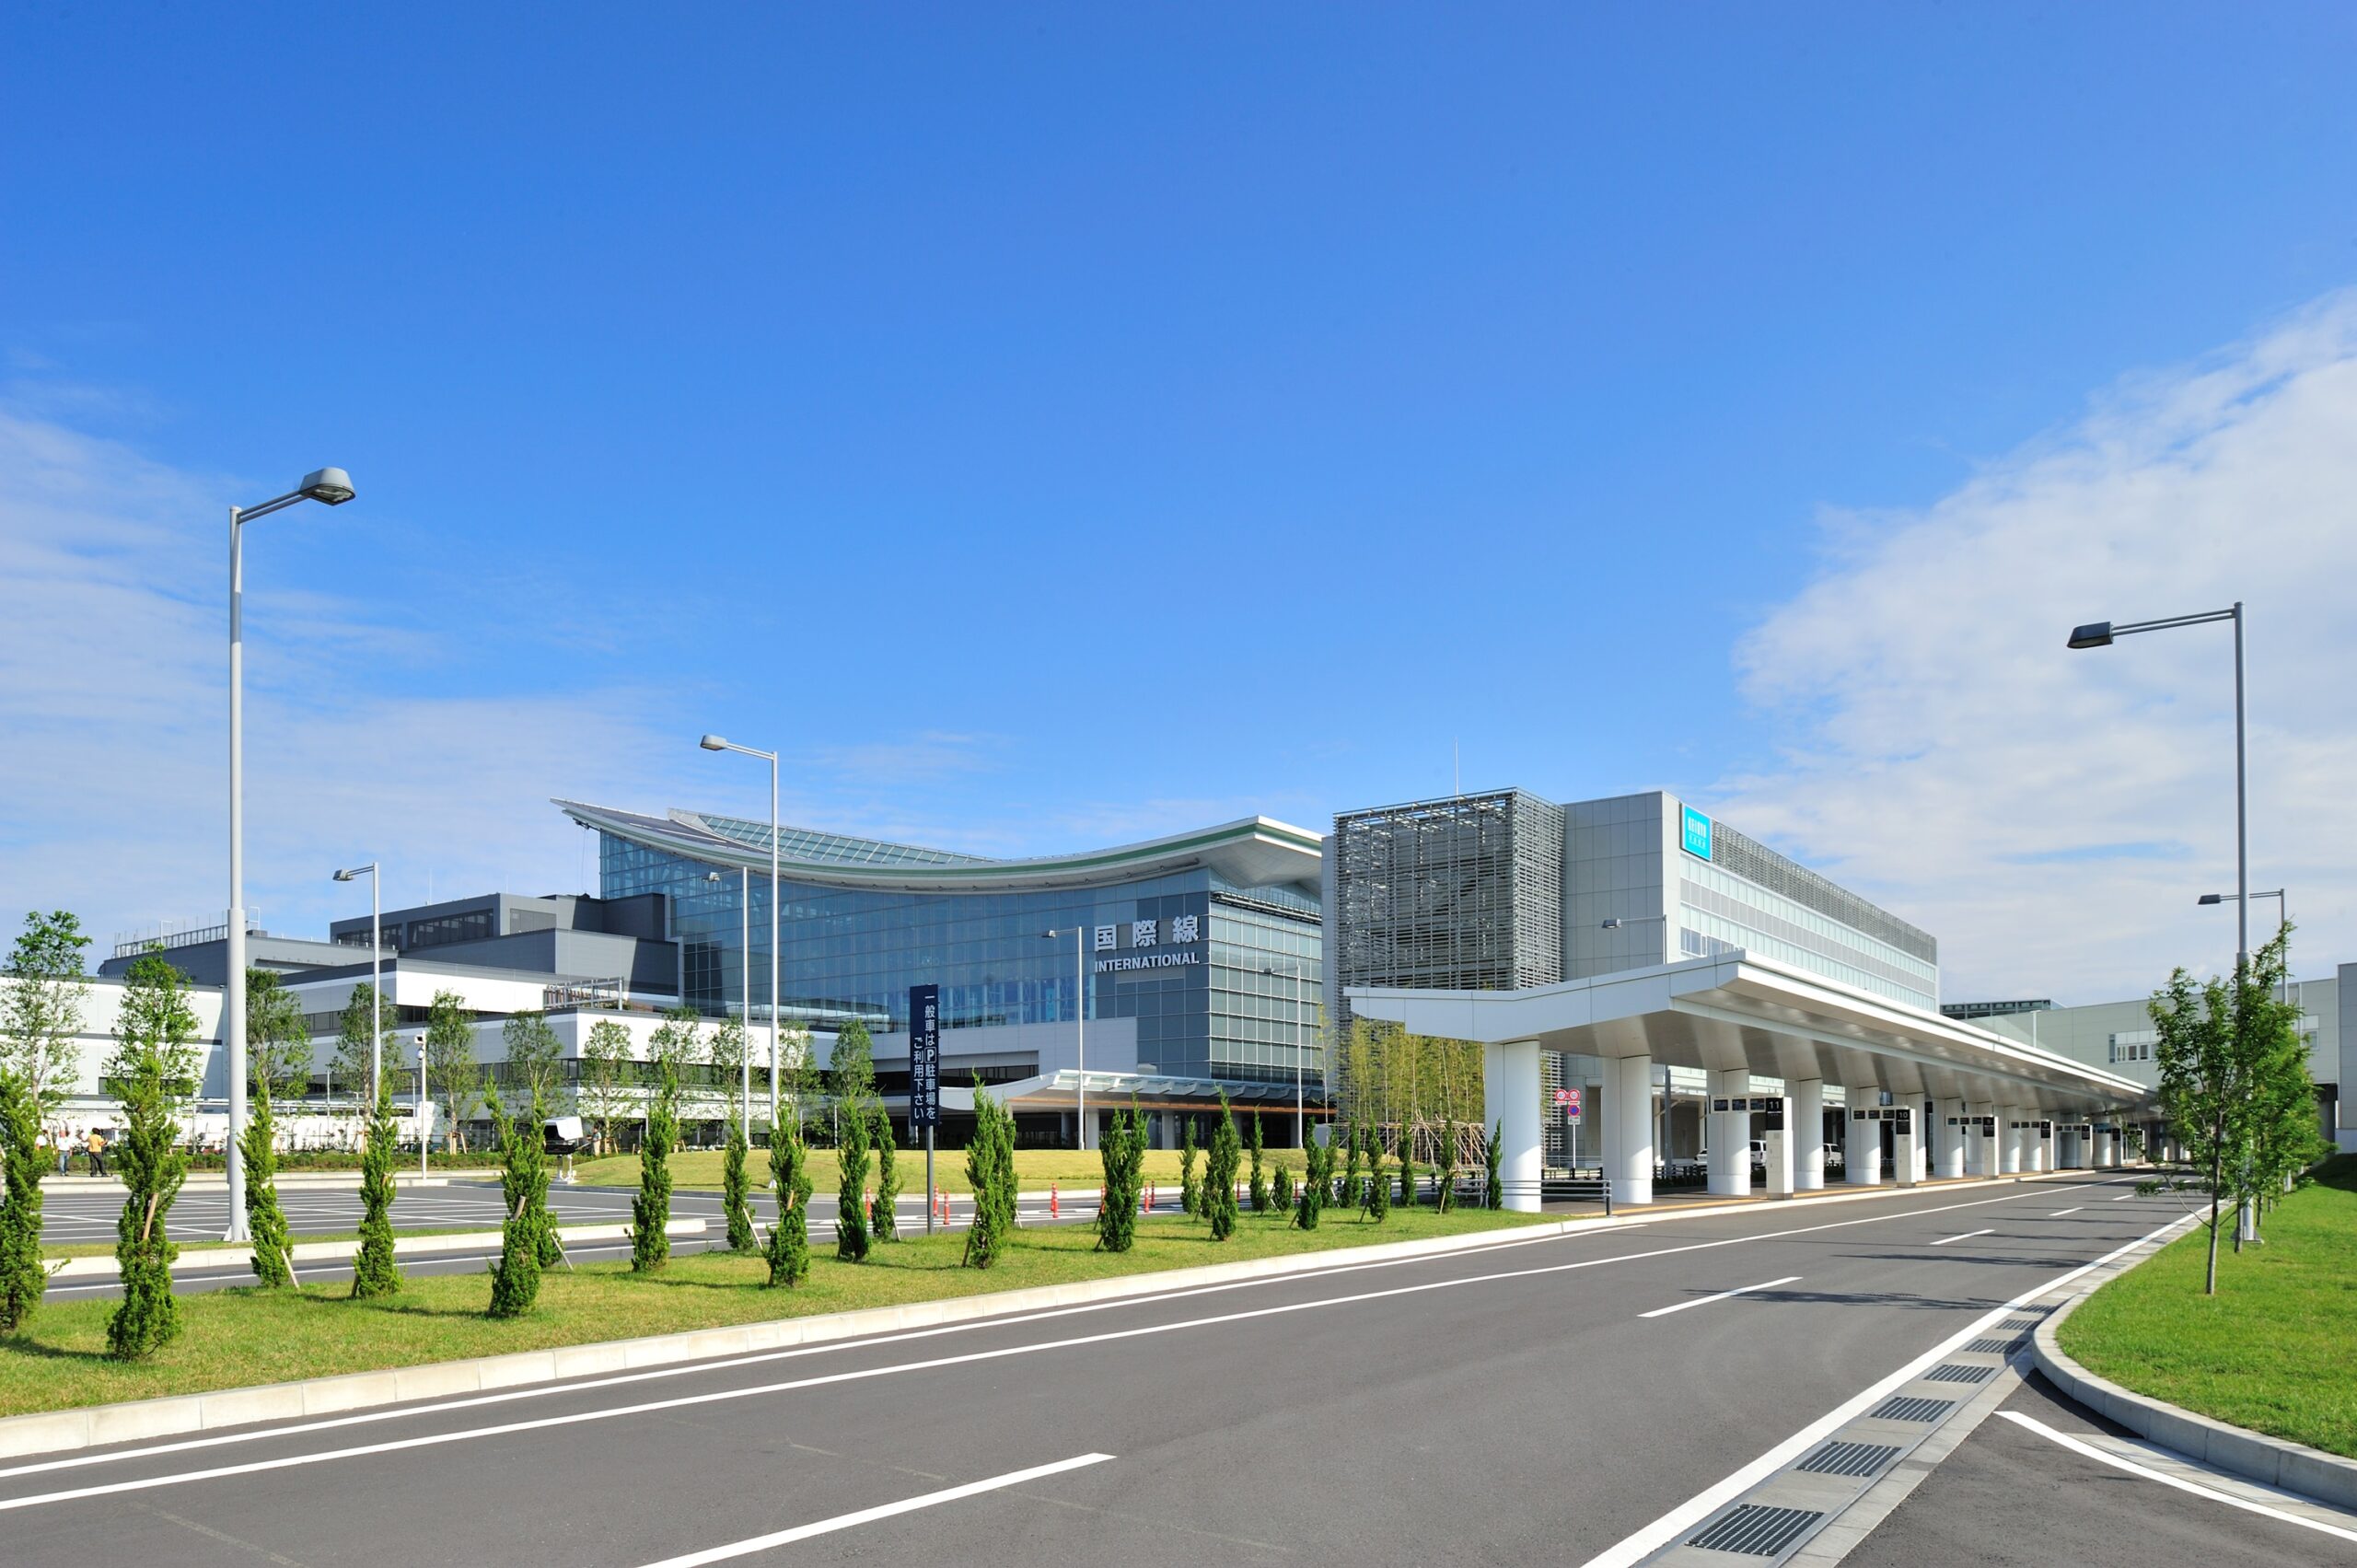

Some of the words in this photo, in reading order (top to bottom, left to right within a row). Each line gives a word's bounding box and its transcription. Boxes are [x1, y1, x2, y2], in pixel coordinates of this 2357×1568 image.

[1095, 915, 1199, 952] 国際線
[1095, 952, 1199, 972] INTERNATIONAL
[913, 1037, 924, 1119] ご利用下さい
